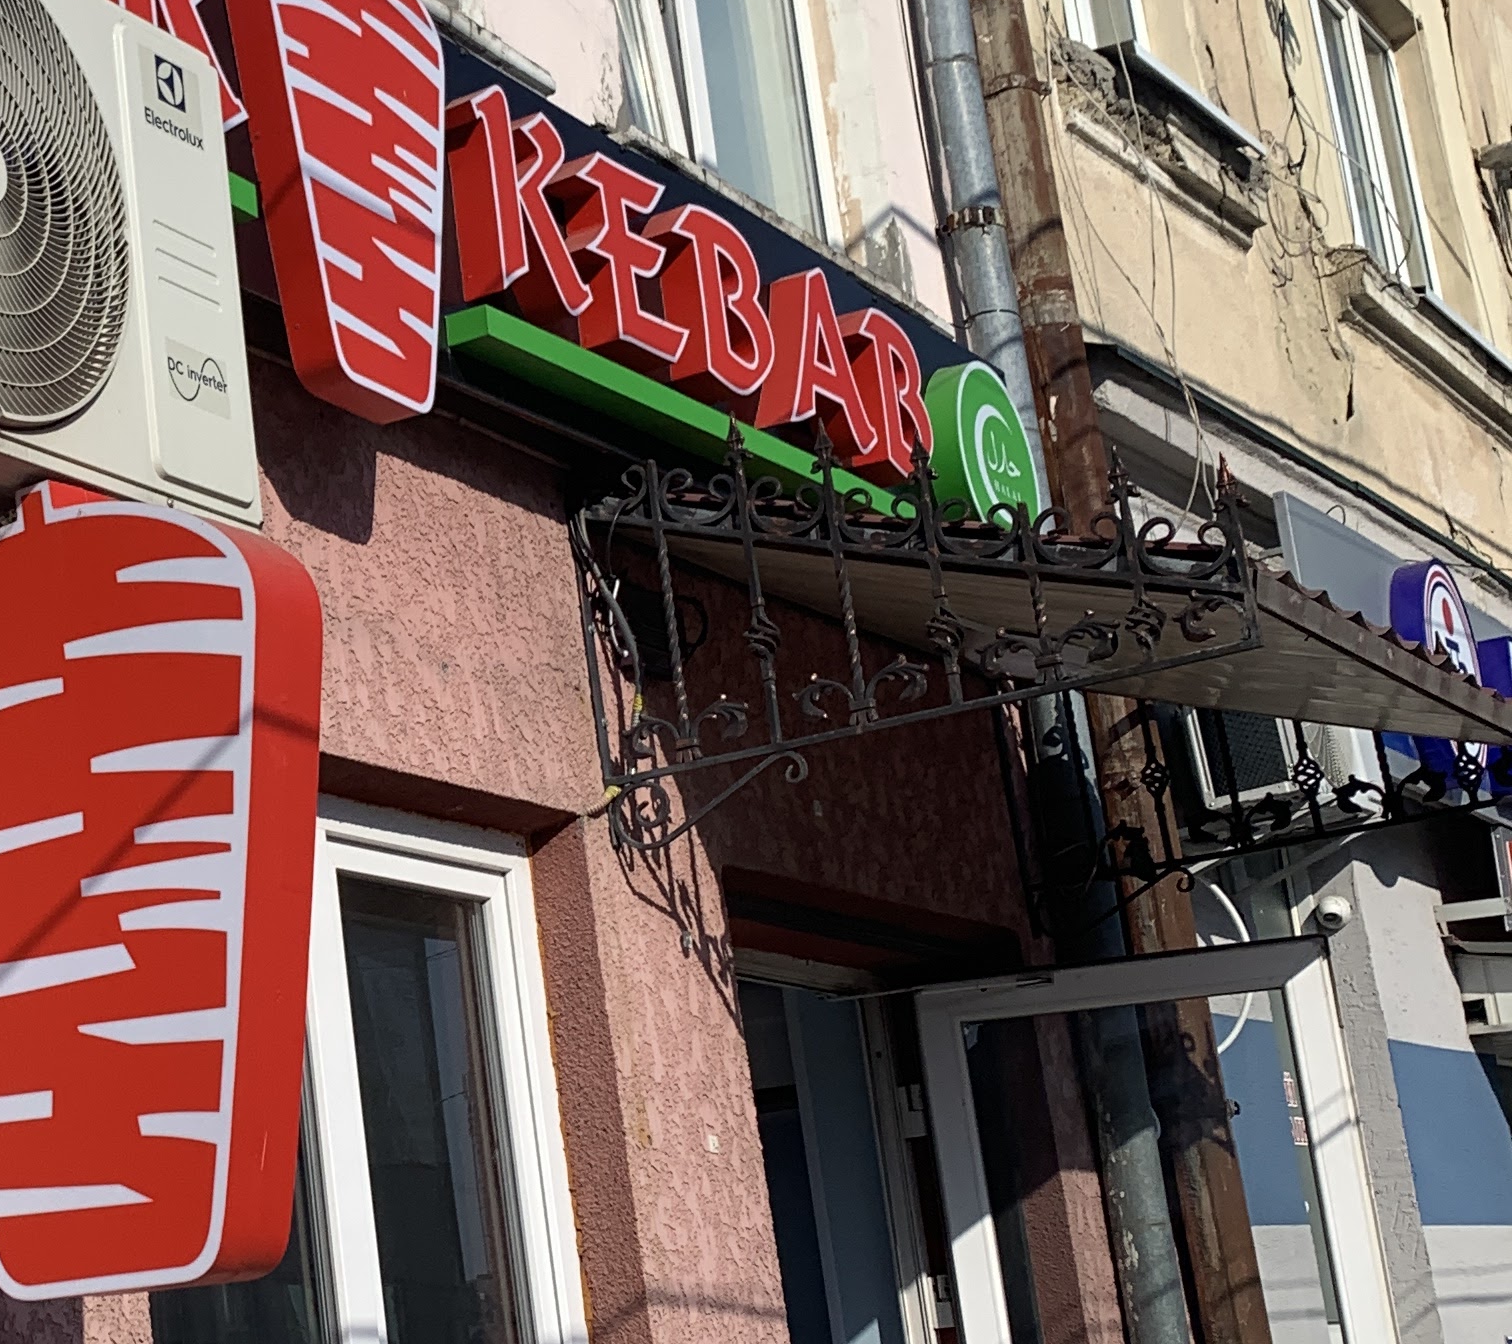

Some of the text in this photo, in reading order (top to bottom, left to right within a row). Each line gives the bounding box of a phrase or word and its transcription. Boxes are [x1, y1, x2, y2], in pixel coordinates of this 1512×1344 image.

[144, 106, 205, 151] Electrolux
[470, 83, 935, 479] KEBAB
[167, 356, 227, 394] DC inverter
